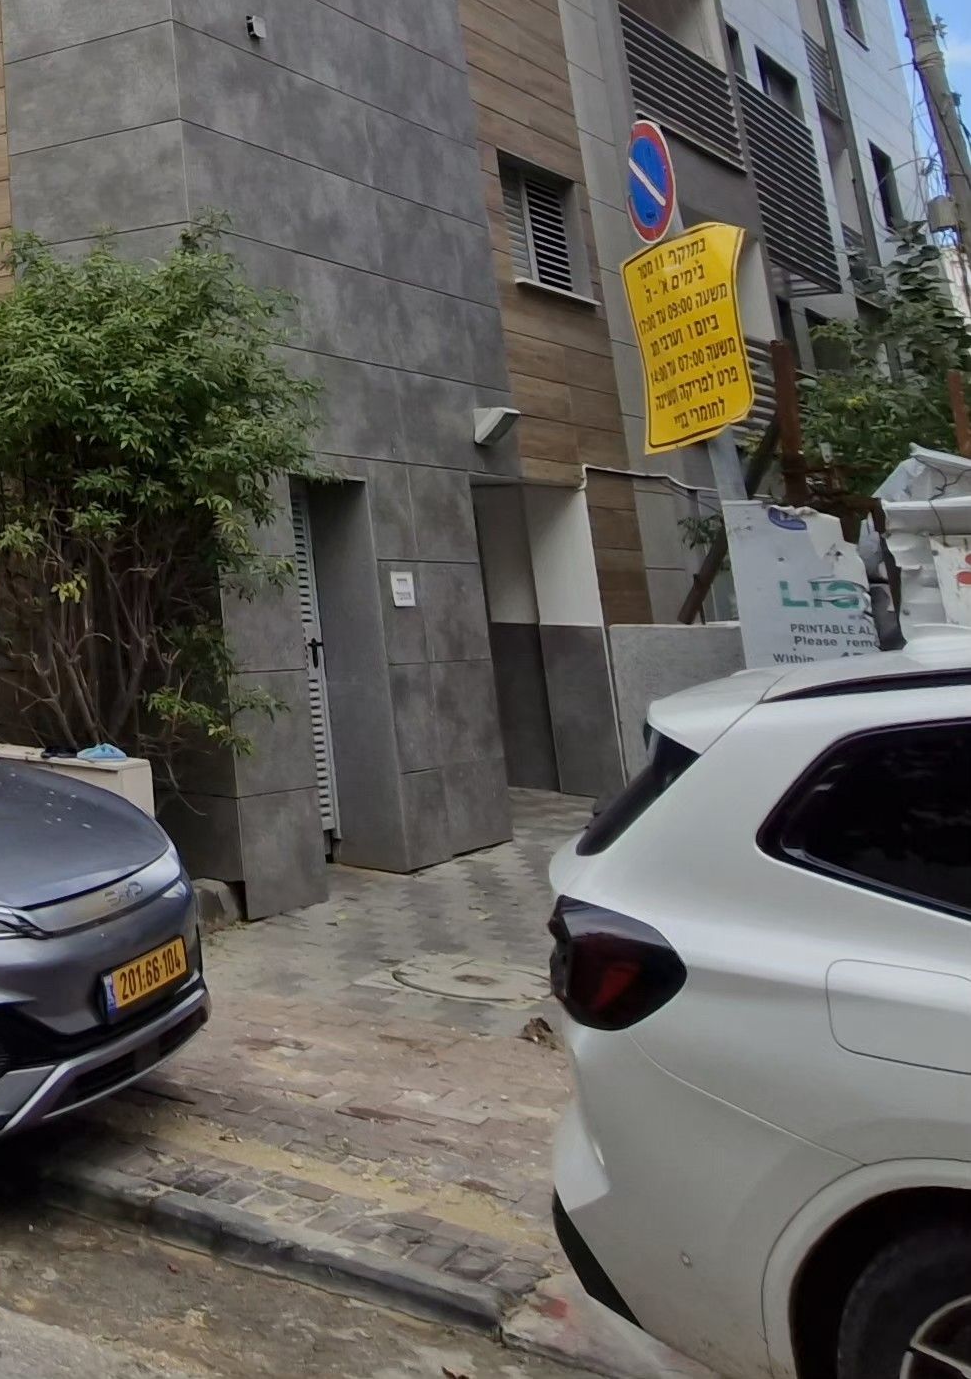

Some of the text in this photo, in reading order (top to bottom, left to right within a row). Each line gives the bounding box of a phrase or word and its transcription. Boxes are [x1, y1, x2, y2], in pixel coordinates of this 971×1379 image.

[695, 282, 727, 308] משעה
[667, 296, 692, 320] 09:00
[694, 314, 719, 336] ביום
[678, 349, 704, 372] 07:00
[705, 337, 736, 361] משעה
[678, 371, 714, 401] לפריקה
[717, 366, 739, 386] פרט
[690, 397, 725, 423] לחומרי
[790, 623, 855, 635] PRINTABLE
[794, 636, 837, 647] Please
